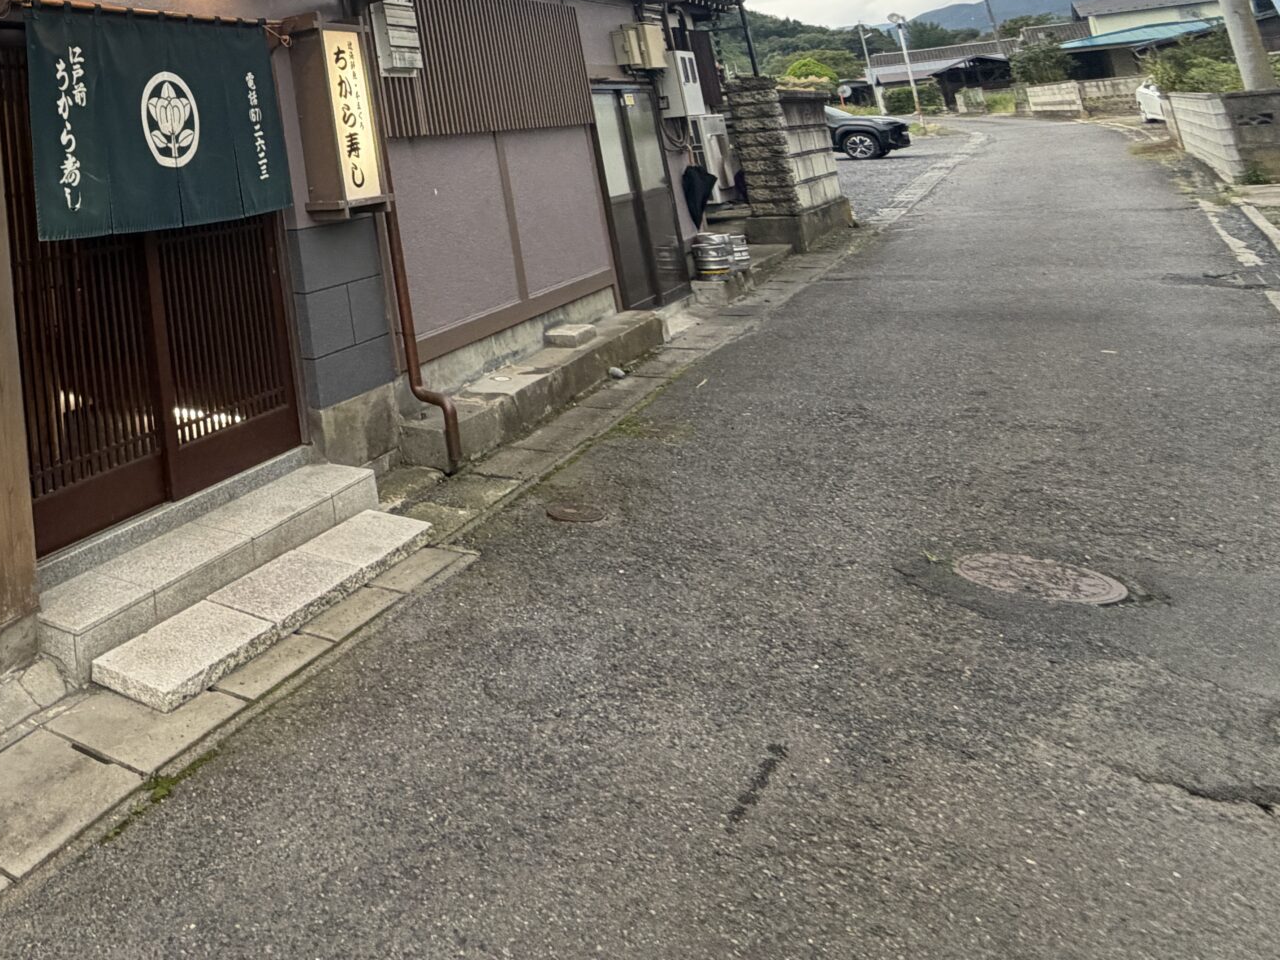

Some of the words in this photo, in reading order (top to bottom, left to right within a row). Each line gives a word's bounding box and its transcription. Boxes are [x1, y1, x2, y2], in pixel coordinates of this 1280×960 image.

[68, 45, 87, 107] 江戸前
[333, 46, 365, 188] ちから寿し
